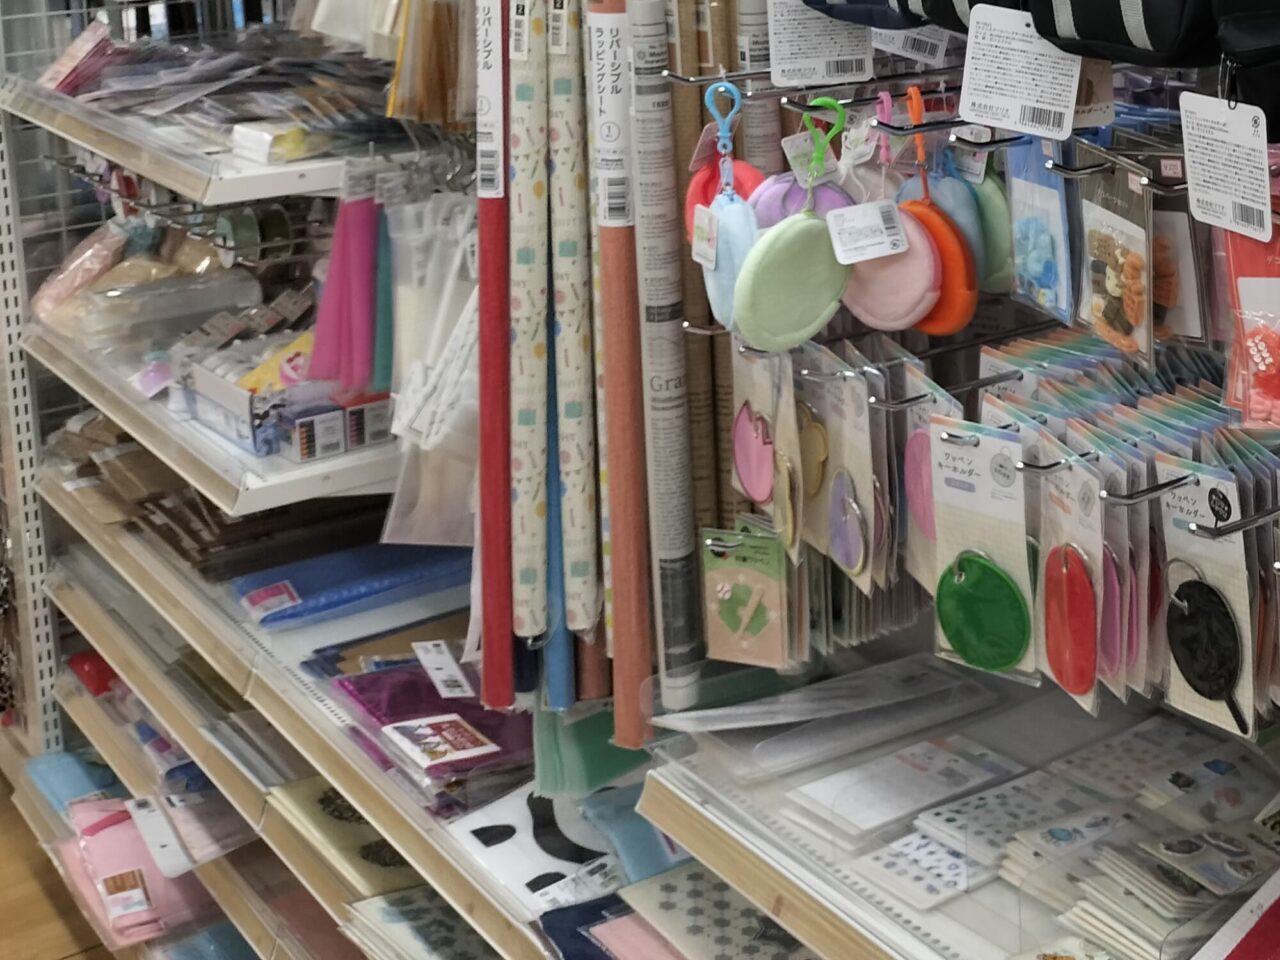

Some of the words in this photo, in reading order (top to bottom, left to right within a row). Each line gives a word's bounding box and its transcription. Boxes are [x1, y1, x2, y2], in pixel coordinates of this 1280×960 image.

[481, 5, 493, 71] リバーシブル
[608, 26, 622, 95] リバーシブル
[938, 462, 982, 477] キーホルダー
[944, 452, 973, 466] ワッペン
